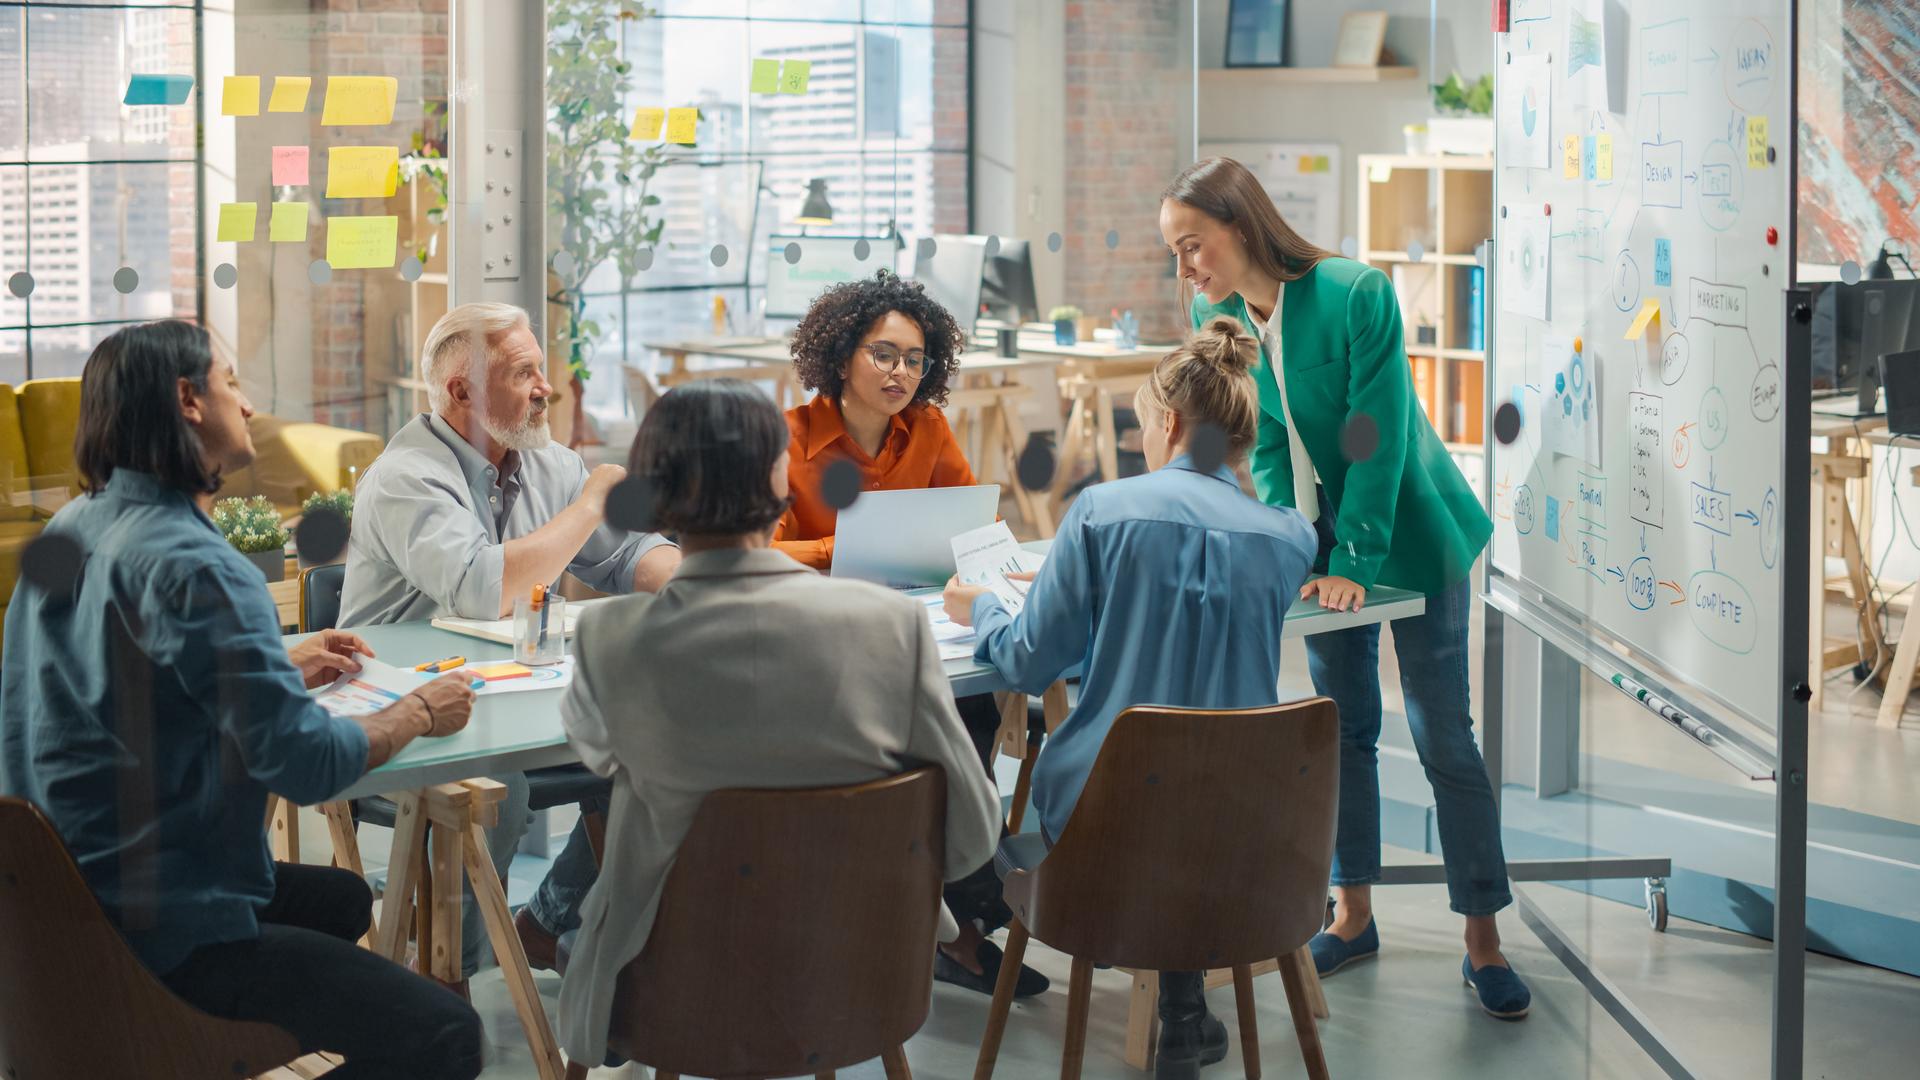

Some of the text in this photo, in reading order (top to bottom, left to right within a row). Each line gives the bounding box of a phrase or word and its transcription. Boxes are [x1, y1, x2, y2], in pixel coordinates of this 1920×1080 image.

[1645, 162, 1673, 182] DESIGN
[1697, 288, 1740, 312] MARKETING
[1695, 494, 1725, 522] SALES
[1632, 573, 1653, 604] 100%
[1695, 584, 1742, 624] COMPLETE
